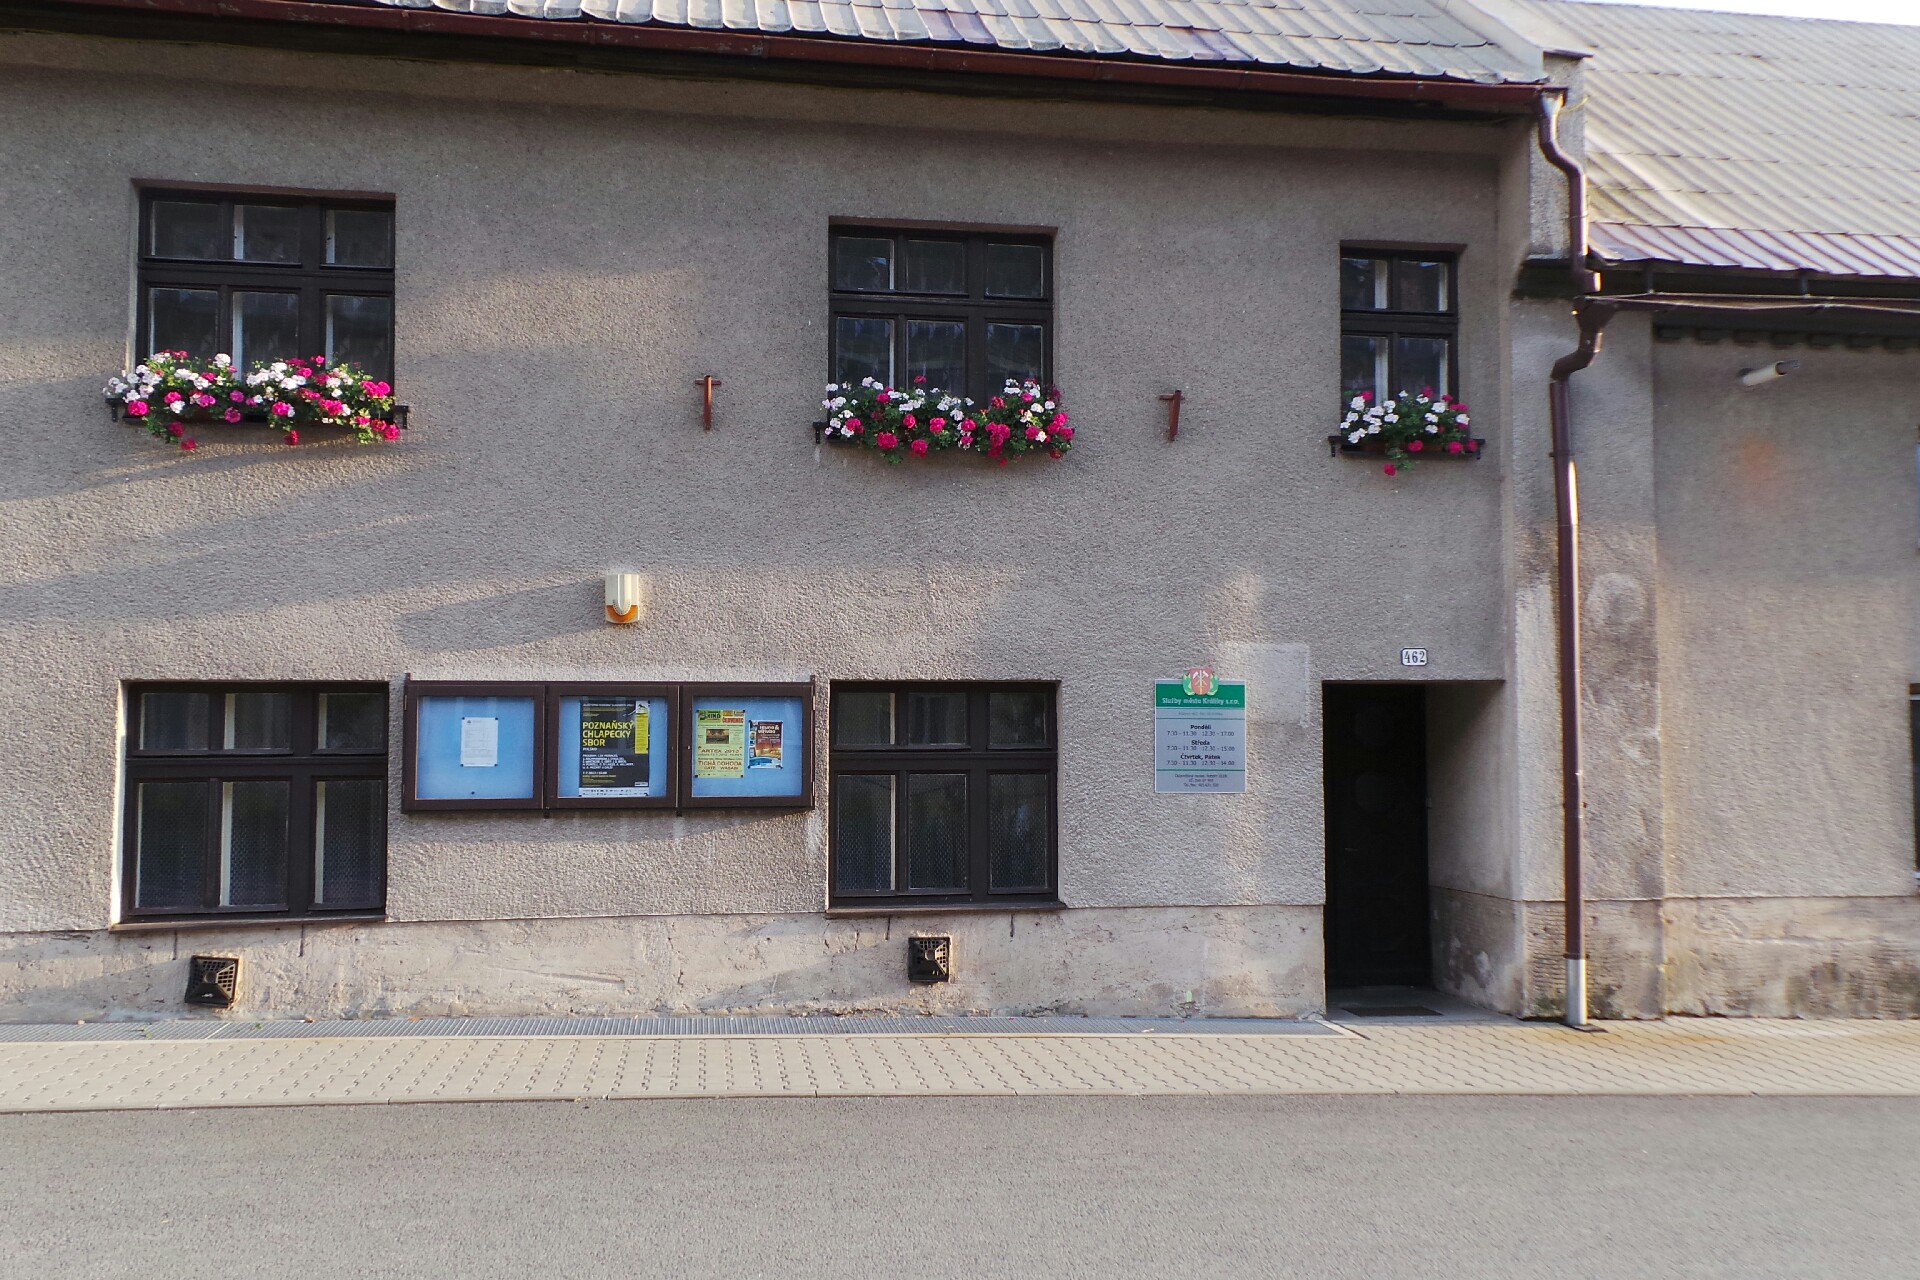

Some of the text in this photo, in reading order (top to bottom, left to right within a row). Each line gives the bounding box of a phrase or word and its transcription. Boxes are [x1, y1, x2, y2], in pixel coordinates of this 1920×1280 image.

[1404, 650, 1426, 664] 462
[1162, 697, 1182, 705] Služby
[582, 739, 606, 747] SBOR
